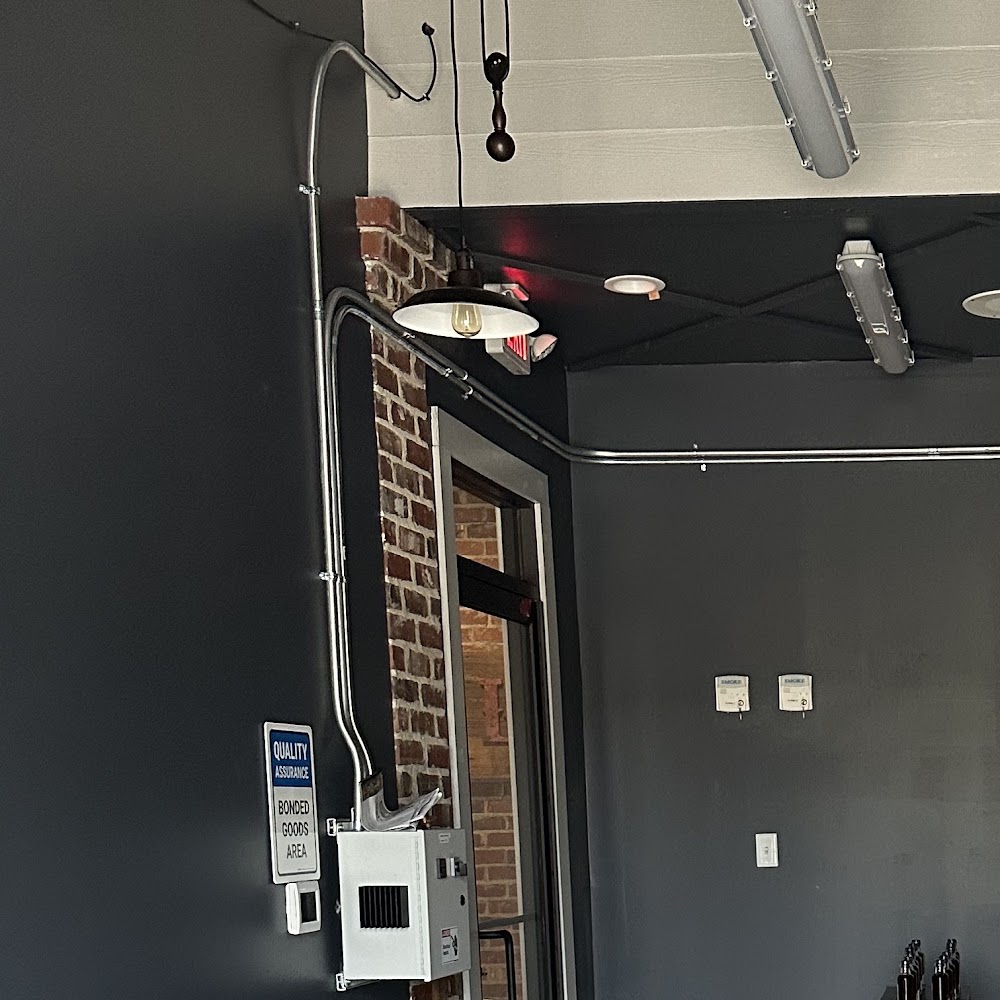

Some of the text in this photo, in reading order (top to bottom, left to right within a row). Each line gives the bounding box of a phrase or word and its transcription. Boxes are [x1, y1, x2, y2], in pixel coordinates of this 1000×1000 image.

[274, 741, 307, 761] QUALITY
[275, 765, 309, 779] ASSURANCE
[279, 800, 310, 815] BONDED
[282, 822, 309, 837] GOODS
[286, 843, 307, 859] AREA
